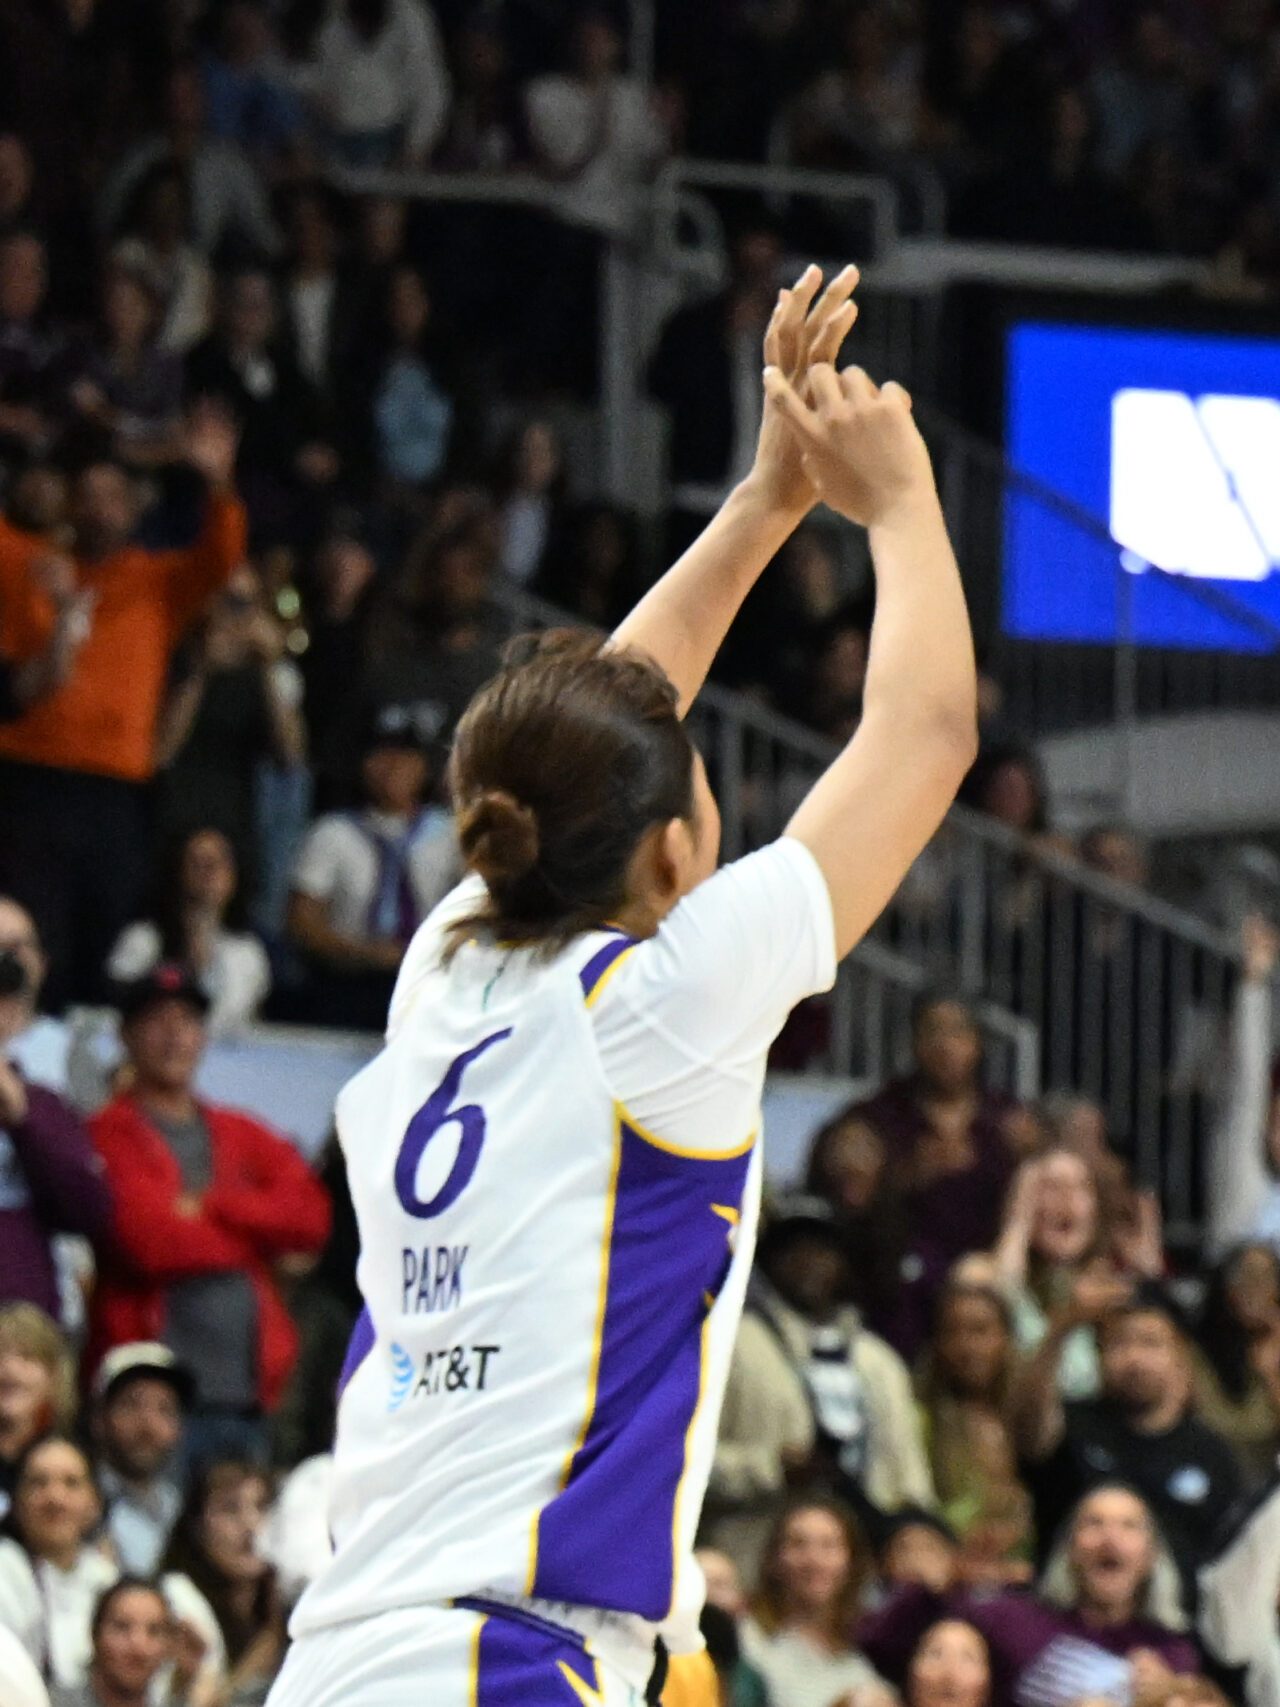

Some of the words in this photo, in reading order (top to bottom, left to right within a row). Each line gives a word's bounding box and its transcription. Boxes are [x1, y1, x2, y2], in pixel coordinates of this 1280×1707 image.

[394, 1026, 514, 1219] 6
[402, 1243, 468, 1315] PARK
[413, 1345, 501, 1398] AT&T
